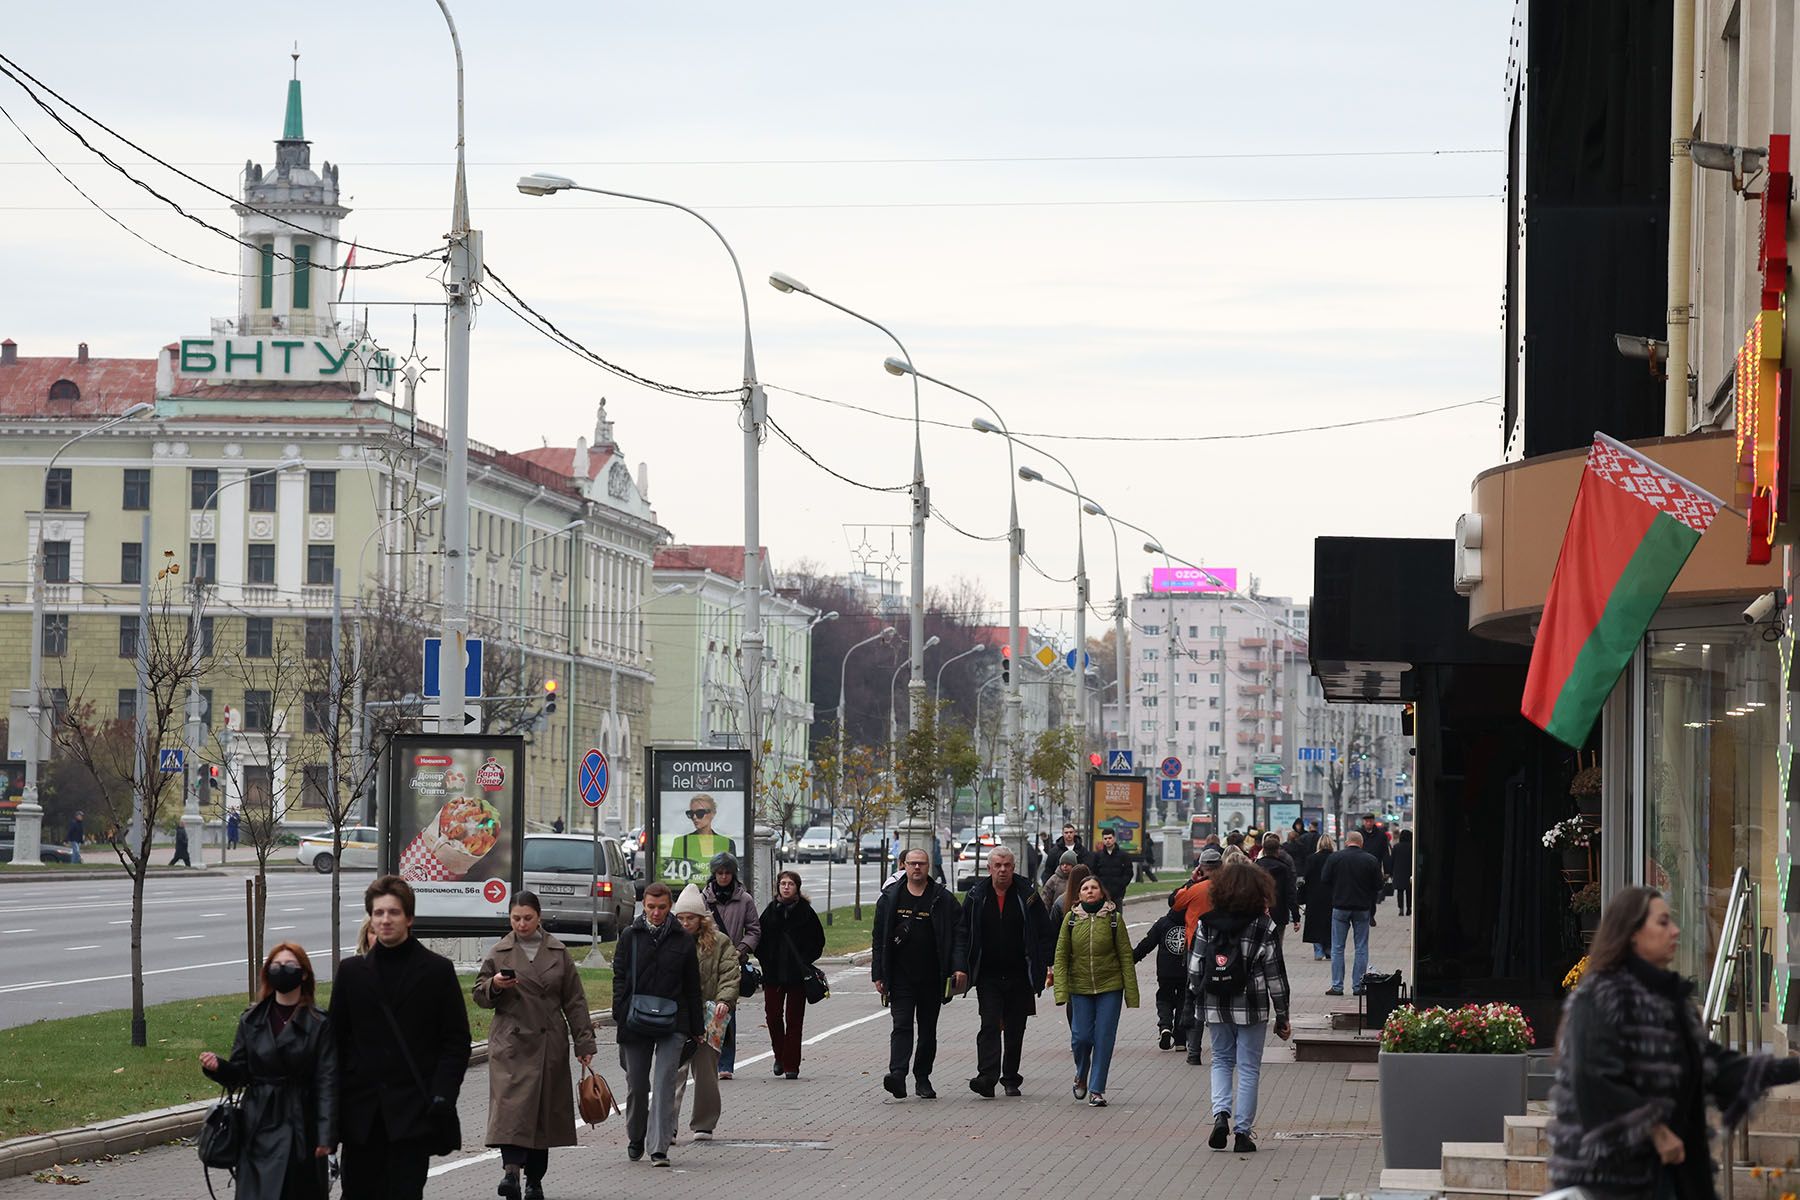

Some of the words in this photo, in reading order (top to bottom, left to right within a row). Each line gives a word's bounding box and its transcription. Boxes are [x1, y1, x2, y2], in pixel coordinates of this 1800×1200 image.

[181, 339, 356, 374] БНТУ
[417, 772, 444, 781] Донер
[477, 769, 499, 779] Papa
[411, 779, 442, 787] Лесные
[420, 787, 445, 795] Опята
[663, 860, 692, 881] 40
